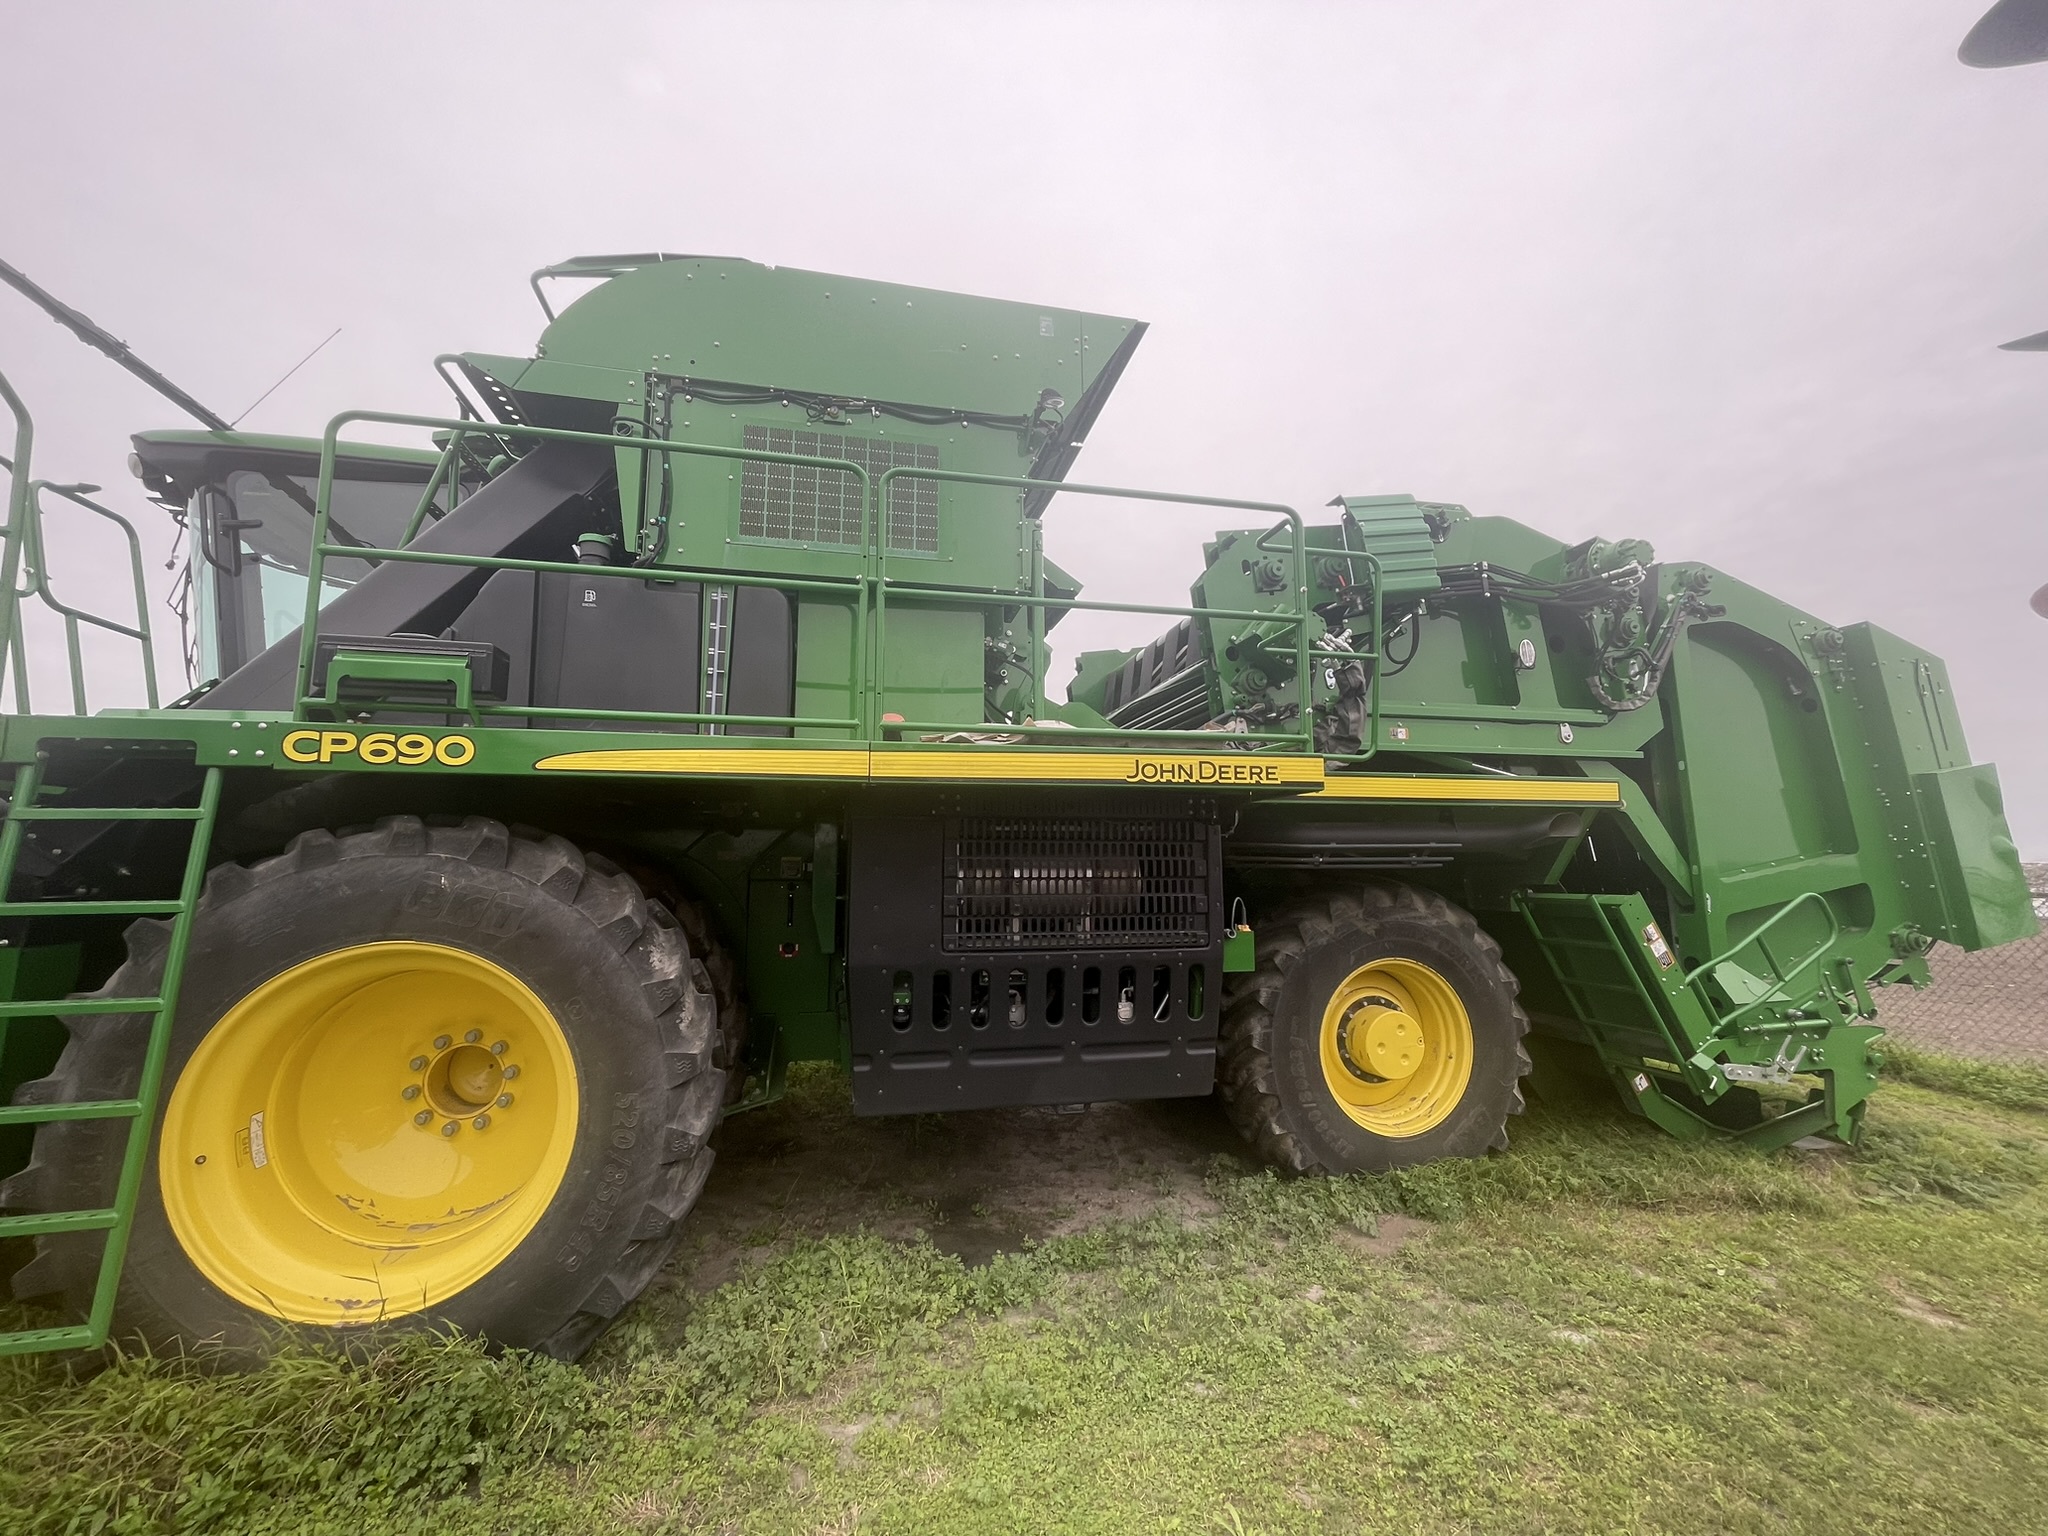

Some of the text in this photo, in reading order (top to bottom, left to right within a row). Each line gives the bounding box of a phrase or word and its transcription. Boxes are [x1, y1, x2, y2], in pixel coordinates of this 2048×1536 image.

[281, 729, 476, 767] CP690
[1126, 759, 1279, 782] JOHN DEERE
